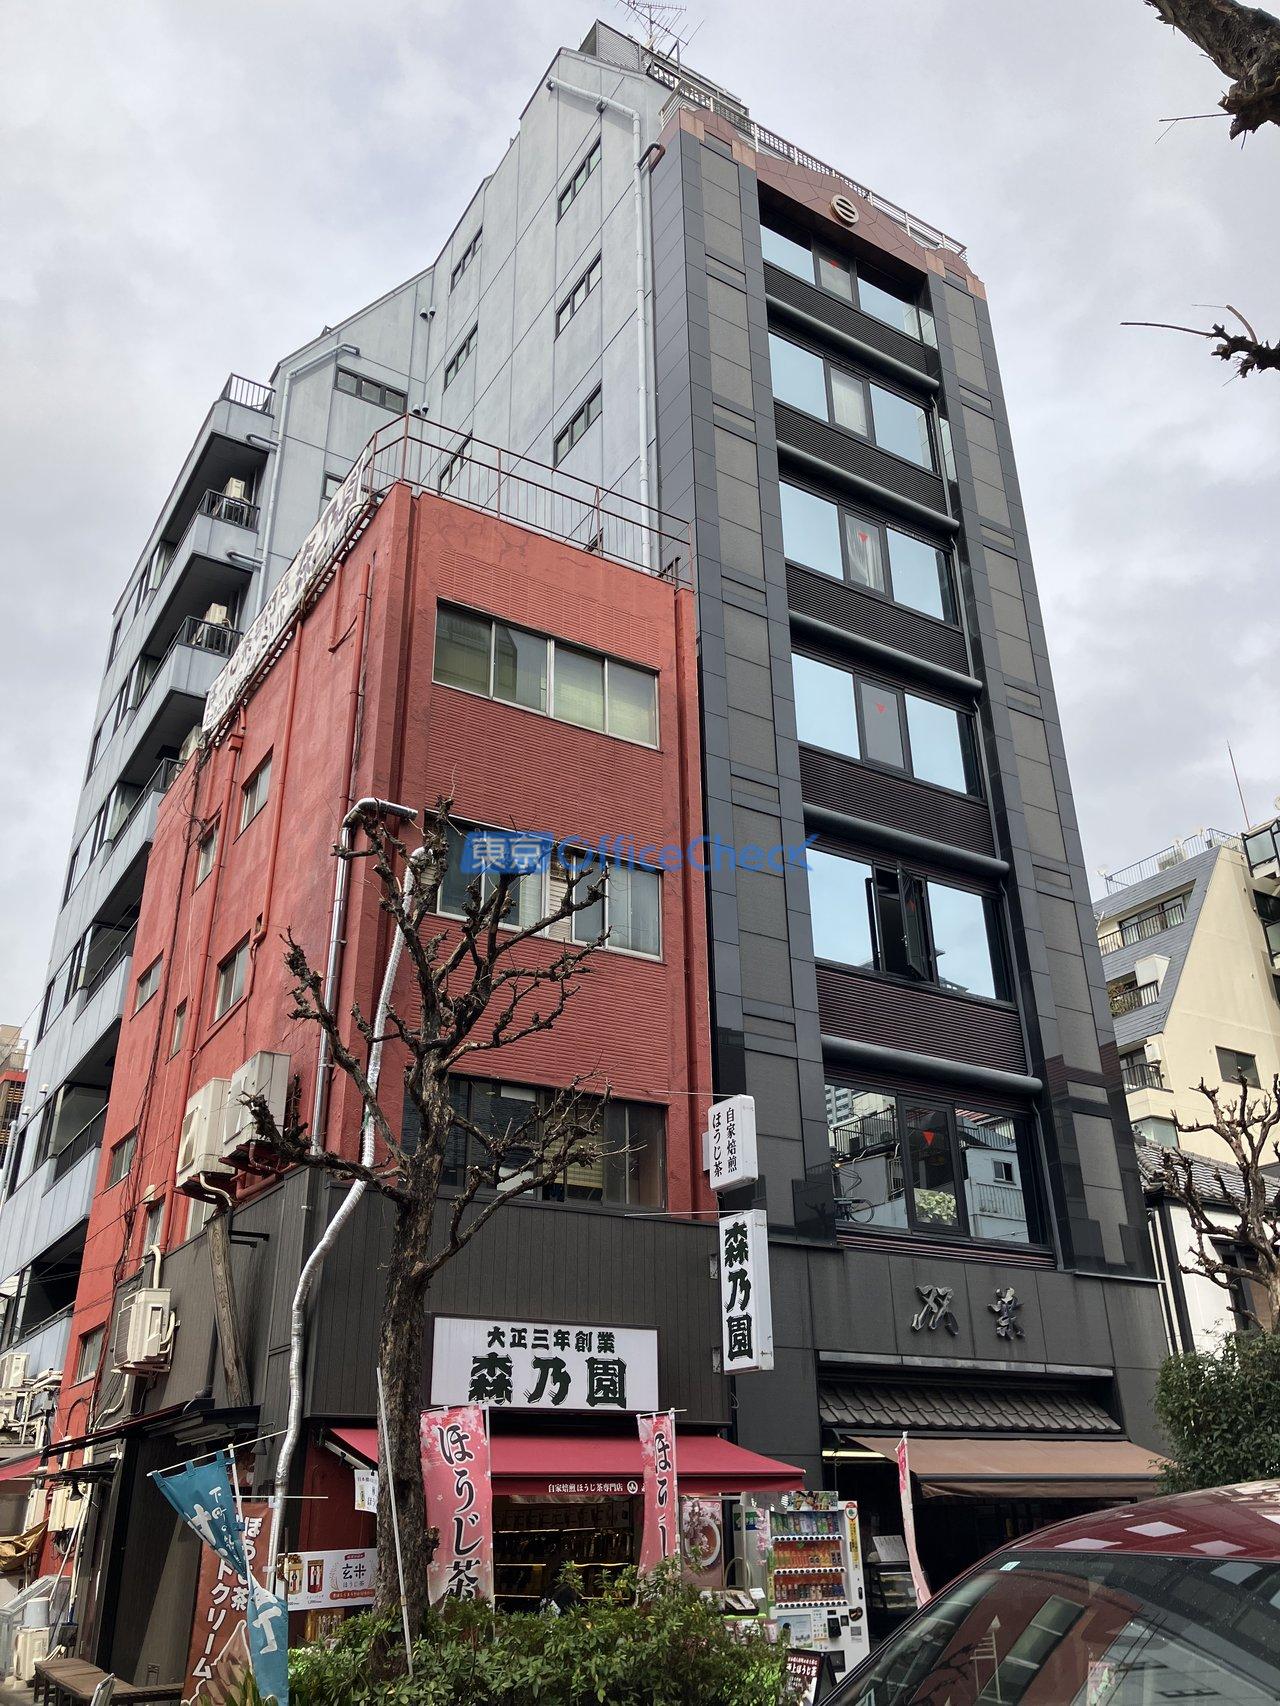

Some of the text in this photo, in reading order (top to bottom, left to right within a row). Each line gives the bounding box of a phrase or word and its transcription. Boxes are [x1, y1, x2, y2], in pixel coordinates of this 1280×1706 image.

[711, 1112, 723, 1178] ほうじ茶
[725, 1106, 738, 1174] 自家焙煎
[724, 1221, 753, 1362] 森乃園
[487, 1325, 616, 1354] 大正三年創業
[468, 1351, 627, 1409] 森乃園
[438, 1424, 484, 1600] ほうじ茶
[548, 1482, 624, 1493] 自家焙煎ほうじ茶専門店
[342, 1562, 367, 1580] 玄米
